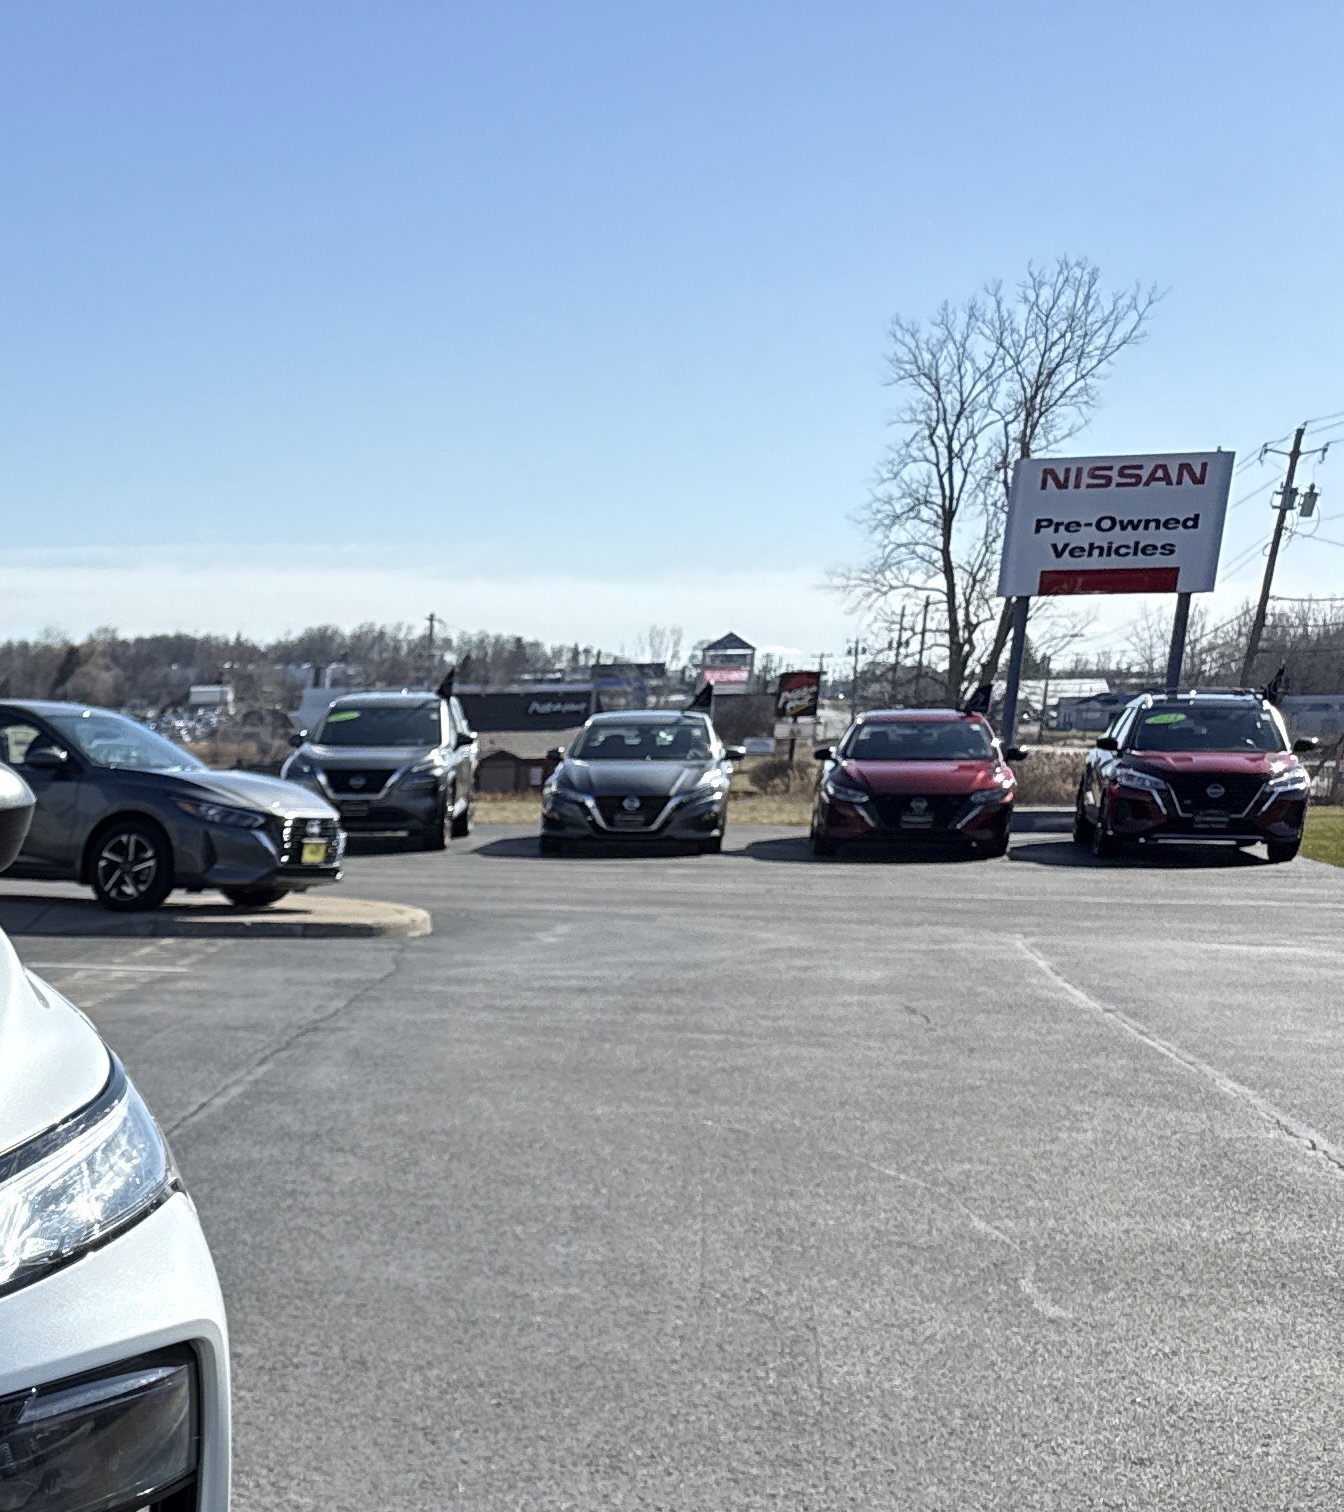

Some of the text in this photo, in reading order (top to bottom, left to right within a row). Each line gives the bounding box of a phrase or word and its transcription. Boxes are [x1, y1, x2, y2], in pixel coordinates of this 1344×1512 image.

[1040, 462, 1208, 490] NISSAN
[1034, 513, 1200, 534] Pre-Owned
[1050, 541, 1177, 559] Vehicles
